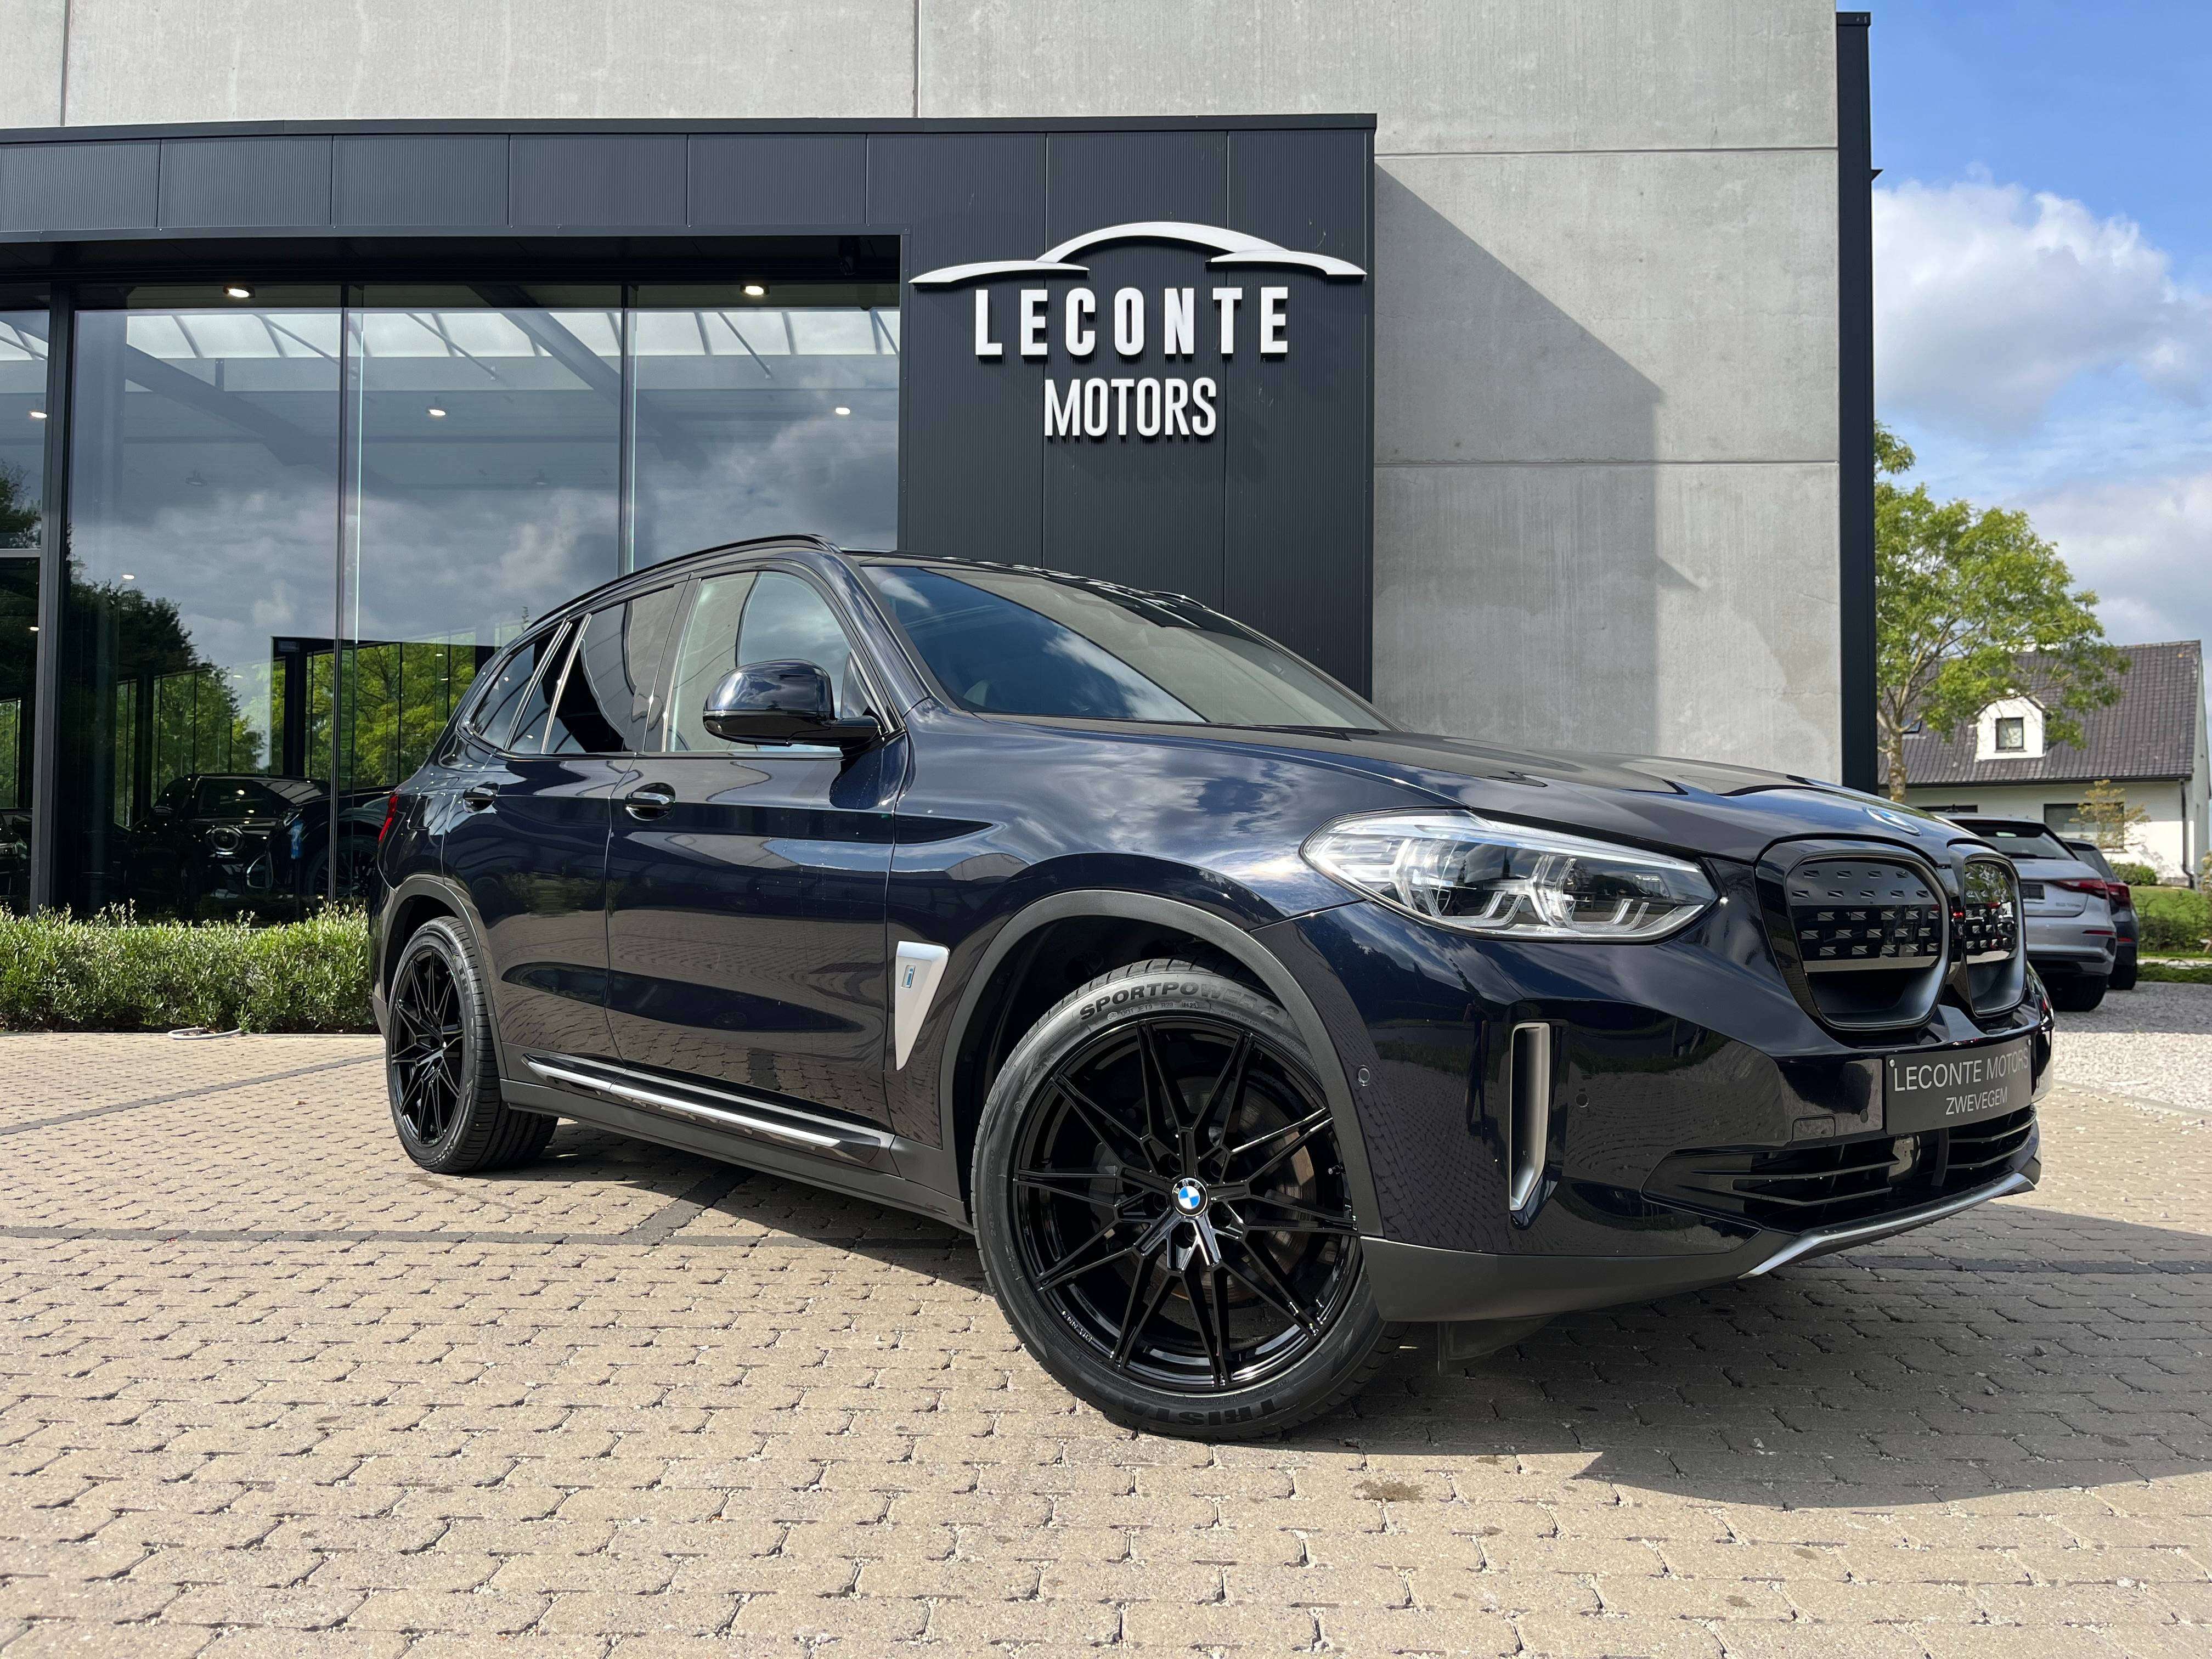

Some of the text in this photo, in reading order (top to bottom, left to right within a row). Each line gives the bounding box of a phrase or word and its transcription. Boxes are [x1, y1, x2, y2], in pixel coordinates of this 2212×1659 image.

[974, 287, 1289, 357] LECONTE
[1045, 377, 1217, 437] MOTORS
[1079, 981, 1257, 1020] SPORTPOWER
[1894, 1047, 2028, 1091] LECONTE MOTORS
[1946, 1087, 2007, 1115] ZWEVEGEM
